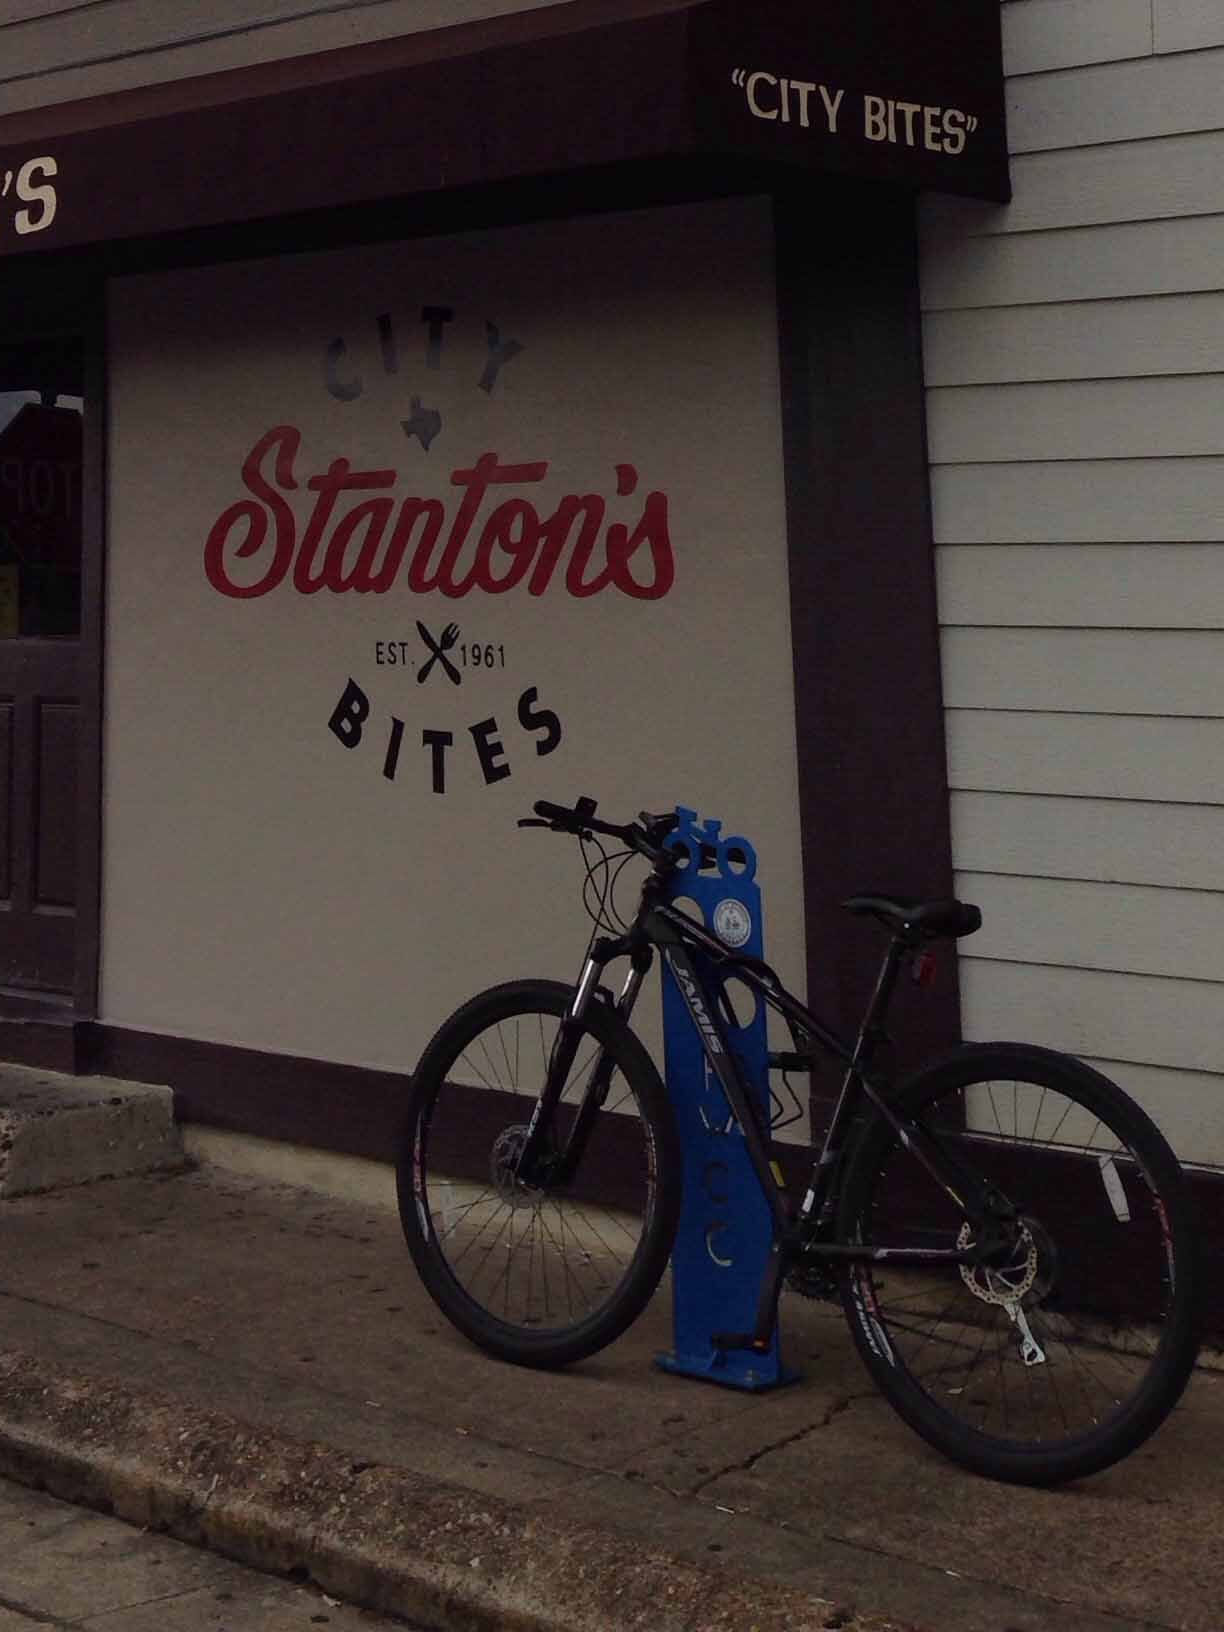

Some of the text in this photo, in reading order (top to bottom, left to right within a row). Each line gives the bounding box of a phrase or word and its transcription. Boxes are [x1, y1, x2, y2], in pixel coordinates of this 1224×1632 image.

[327, 305, 525, 402] CITY
[203, 424, 676, 600] Stanton's
[376, 642, 505, 668] EST. 1961
[328, 677, 562, 794] BITES
